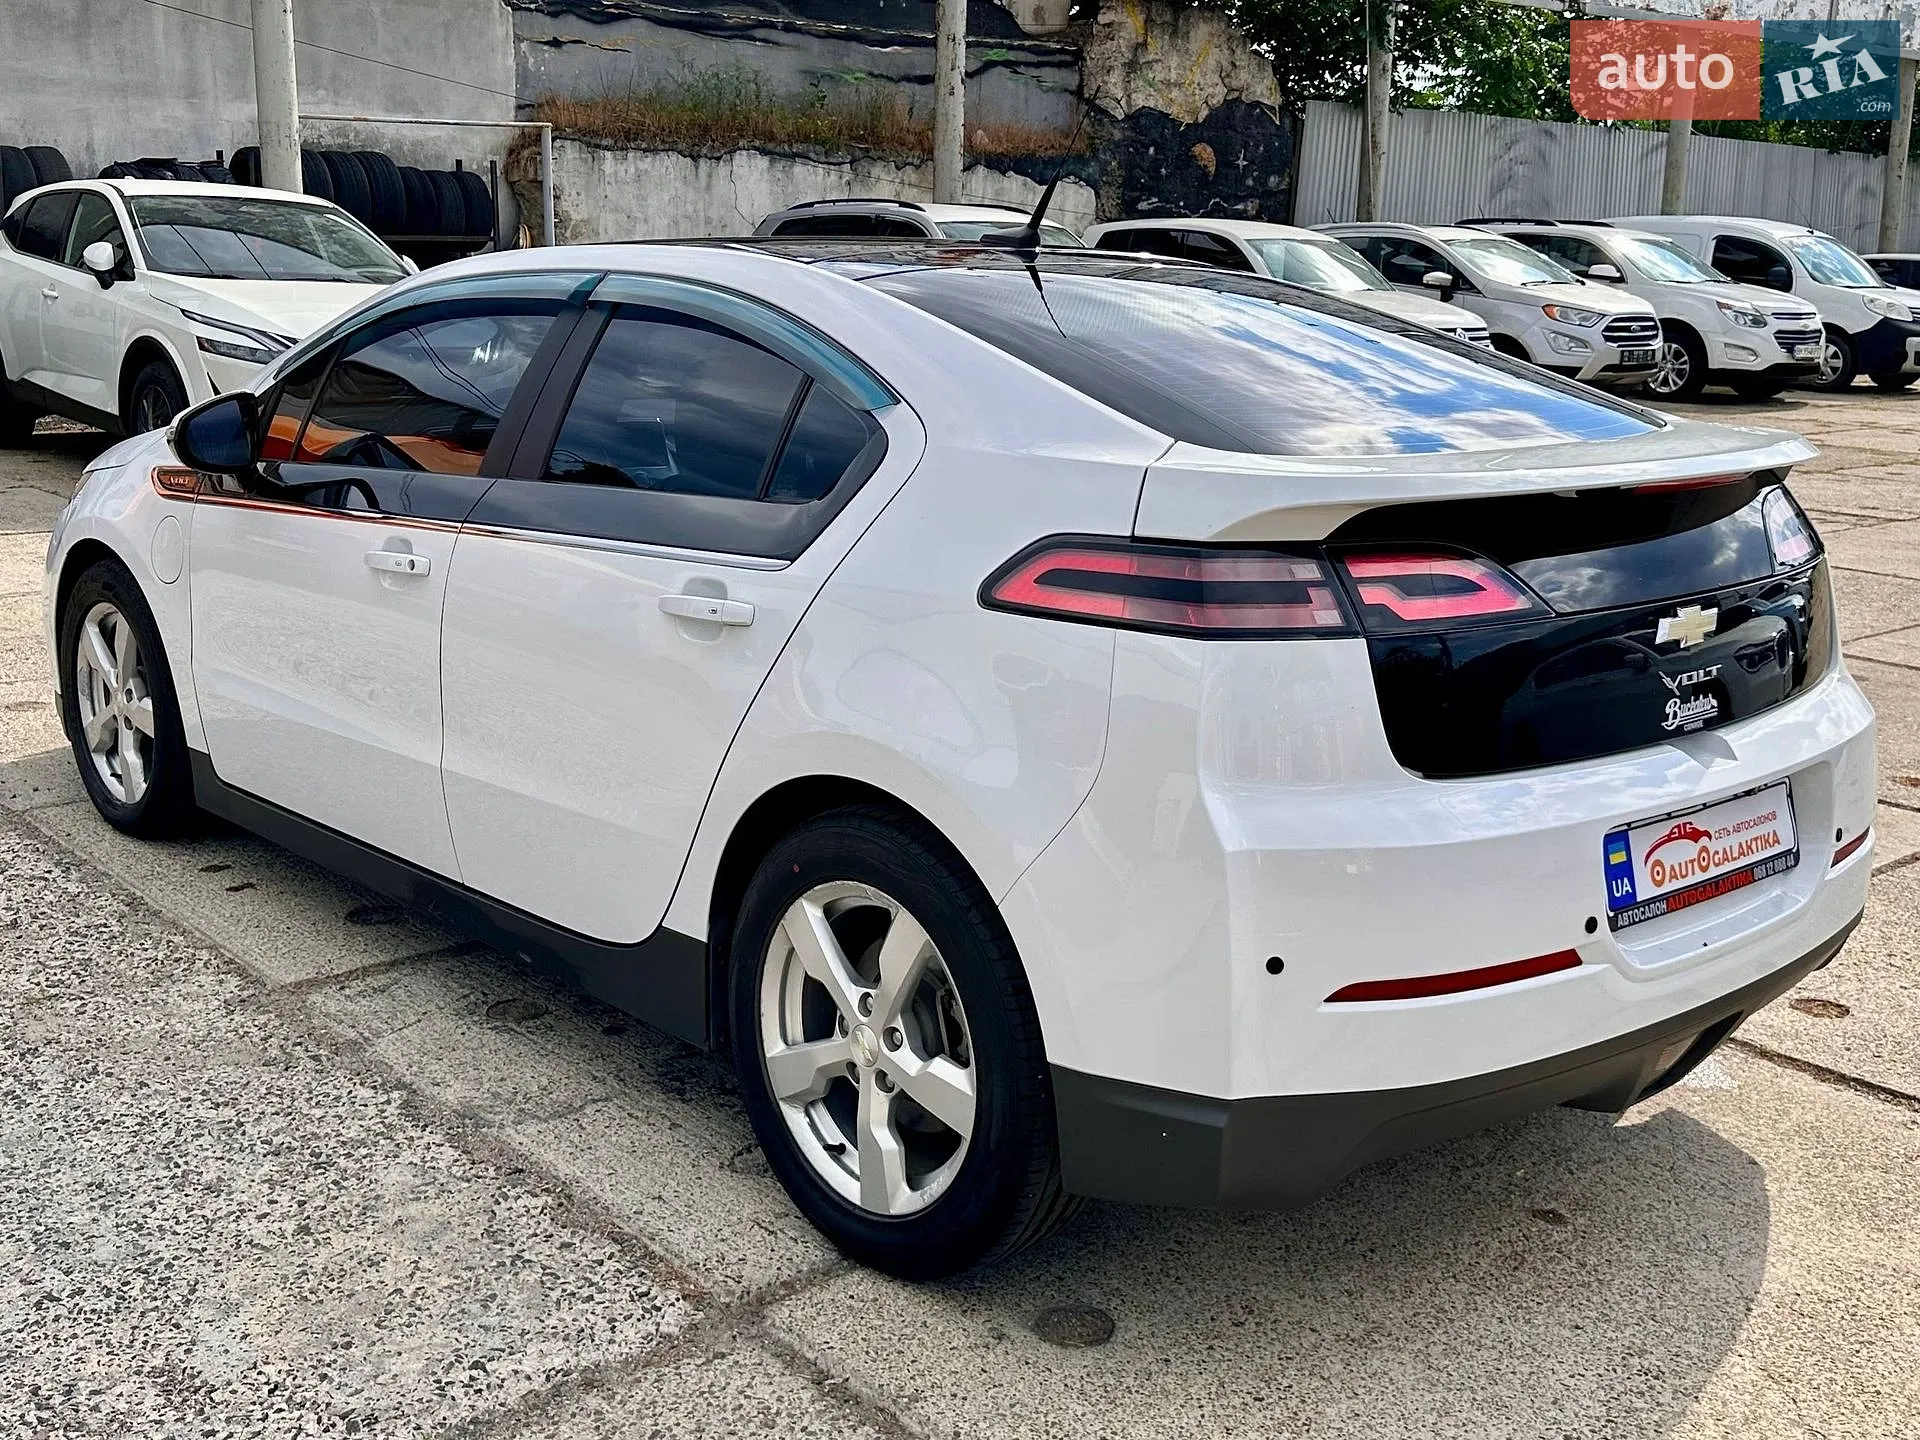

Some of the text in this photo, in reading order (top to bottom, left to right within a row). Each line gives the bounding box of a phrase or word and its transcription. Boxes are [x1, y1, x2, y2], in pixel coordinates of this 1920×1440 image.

[1658, 664, 1723, 696] VOLT
[1714, 811, 1777, 841] СЕТЬ АВТОСАЛОНОВ
[1612, 877, 1632, 898] UA
[1617, 900, 1668, 928] АВТОСАЛОН
[1668, 868, 1753, 912] AUTOGALAKTIKA
[1766, 861, 1775, 876] 12
